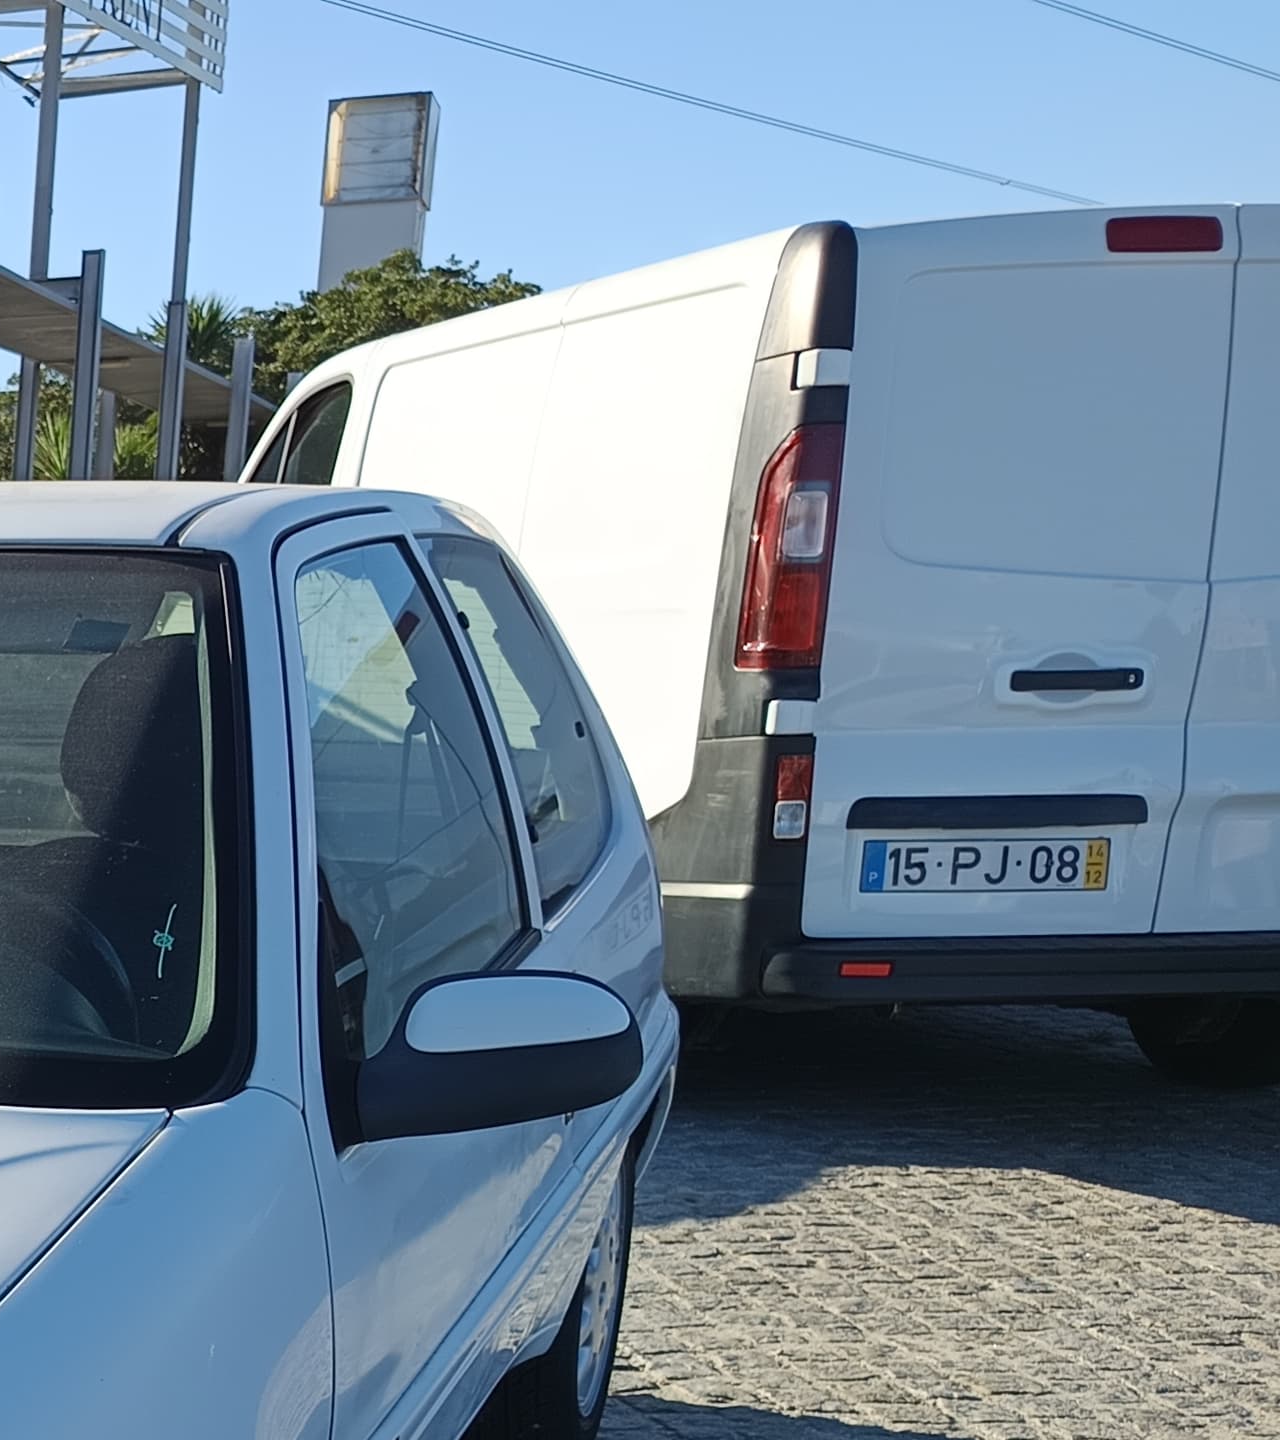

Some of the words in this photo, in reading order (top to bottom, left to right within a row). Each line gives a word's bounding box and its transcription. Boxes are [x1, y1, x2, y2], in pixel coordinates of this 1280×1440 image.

[1088, 844, 1104, 858] 14
[868, 872, 878, 883] P
[1085, 870, 1102, 884] 12
